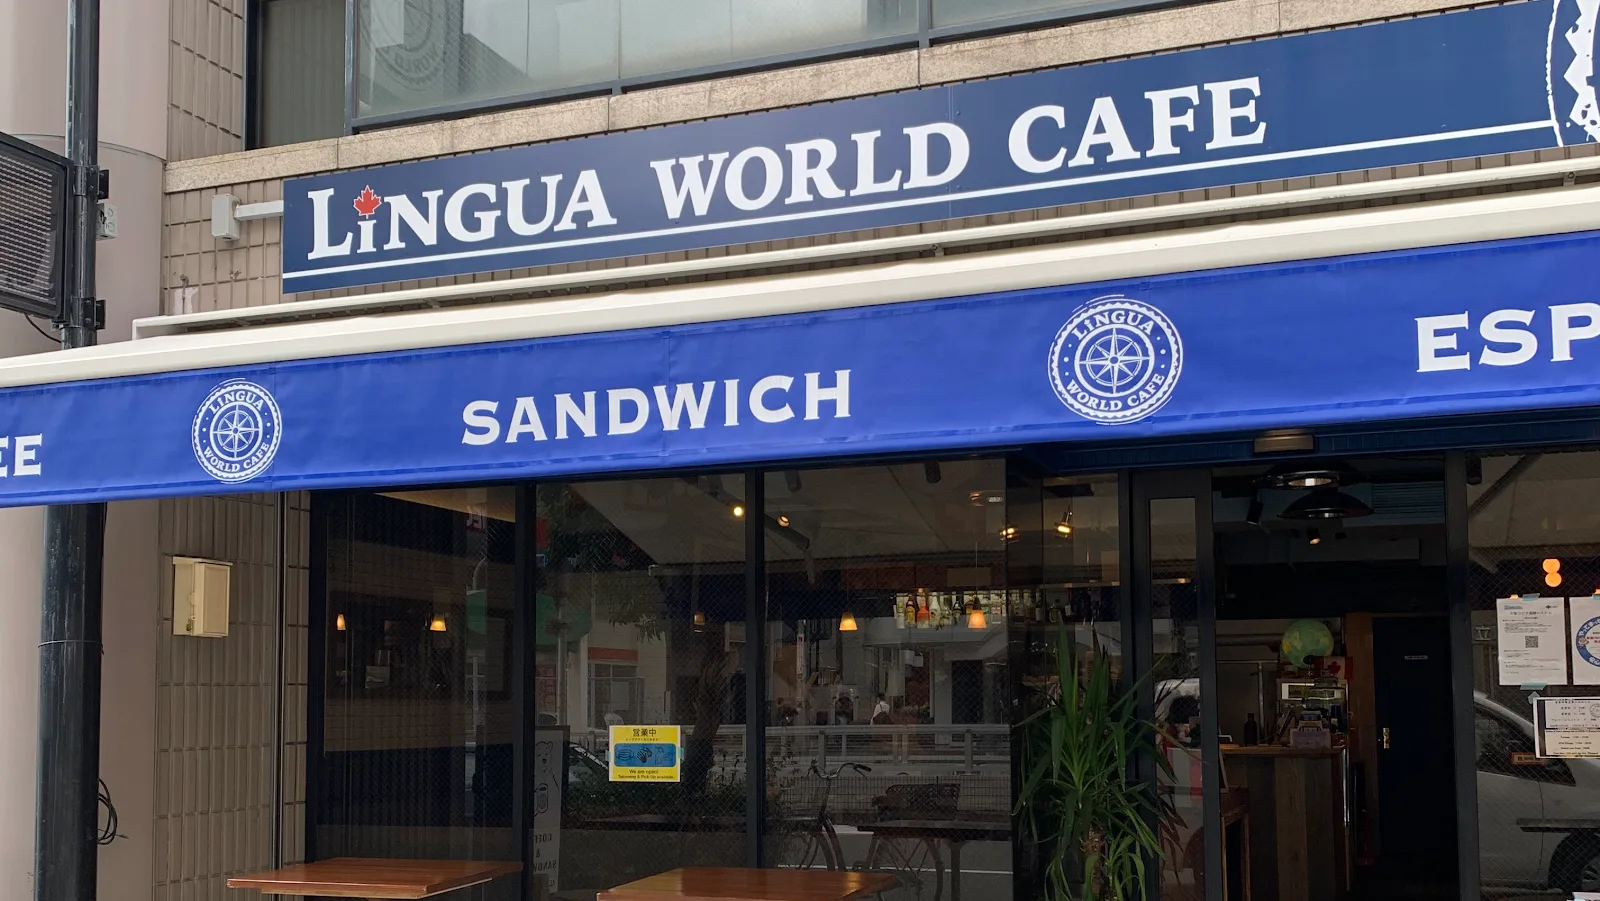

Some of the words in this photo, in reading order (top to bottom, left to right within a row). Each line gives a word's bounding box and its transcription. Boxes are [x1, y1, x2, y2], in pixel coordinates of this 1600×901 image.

[650, 122, 970, 220] WORLD
[1008, 76, 1267, 174] CAFE
[1415, 302, 1600, 373] ESP
[462, 369, 852, 447] SANDWICH
[1066, 379, 1122, 411] WORLD
[1127, 373, 1165, 407] CAFE
[203, 446, 240, 472] WORLD
[243, 442, 270, 469] CAFE
[633, 728, 657, 737] 営業中
